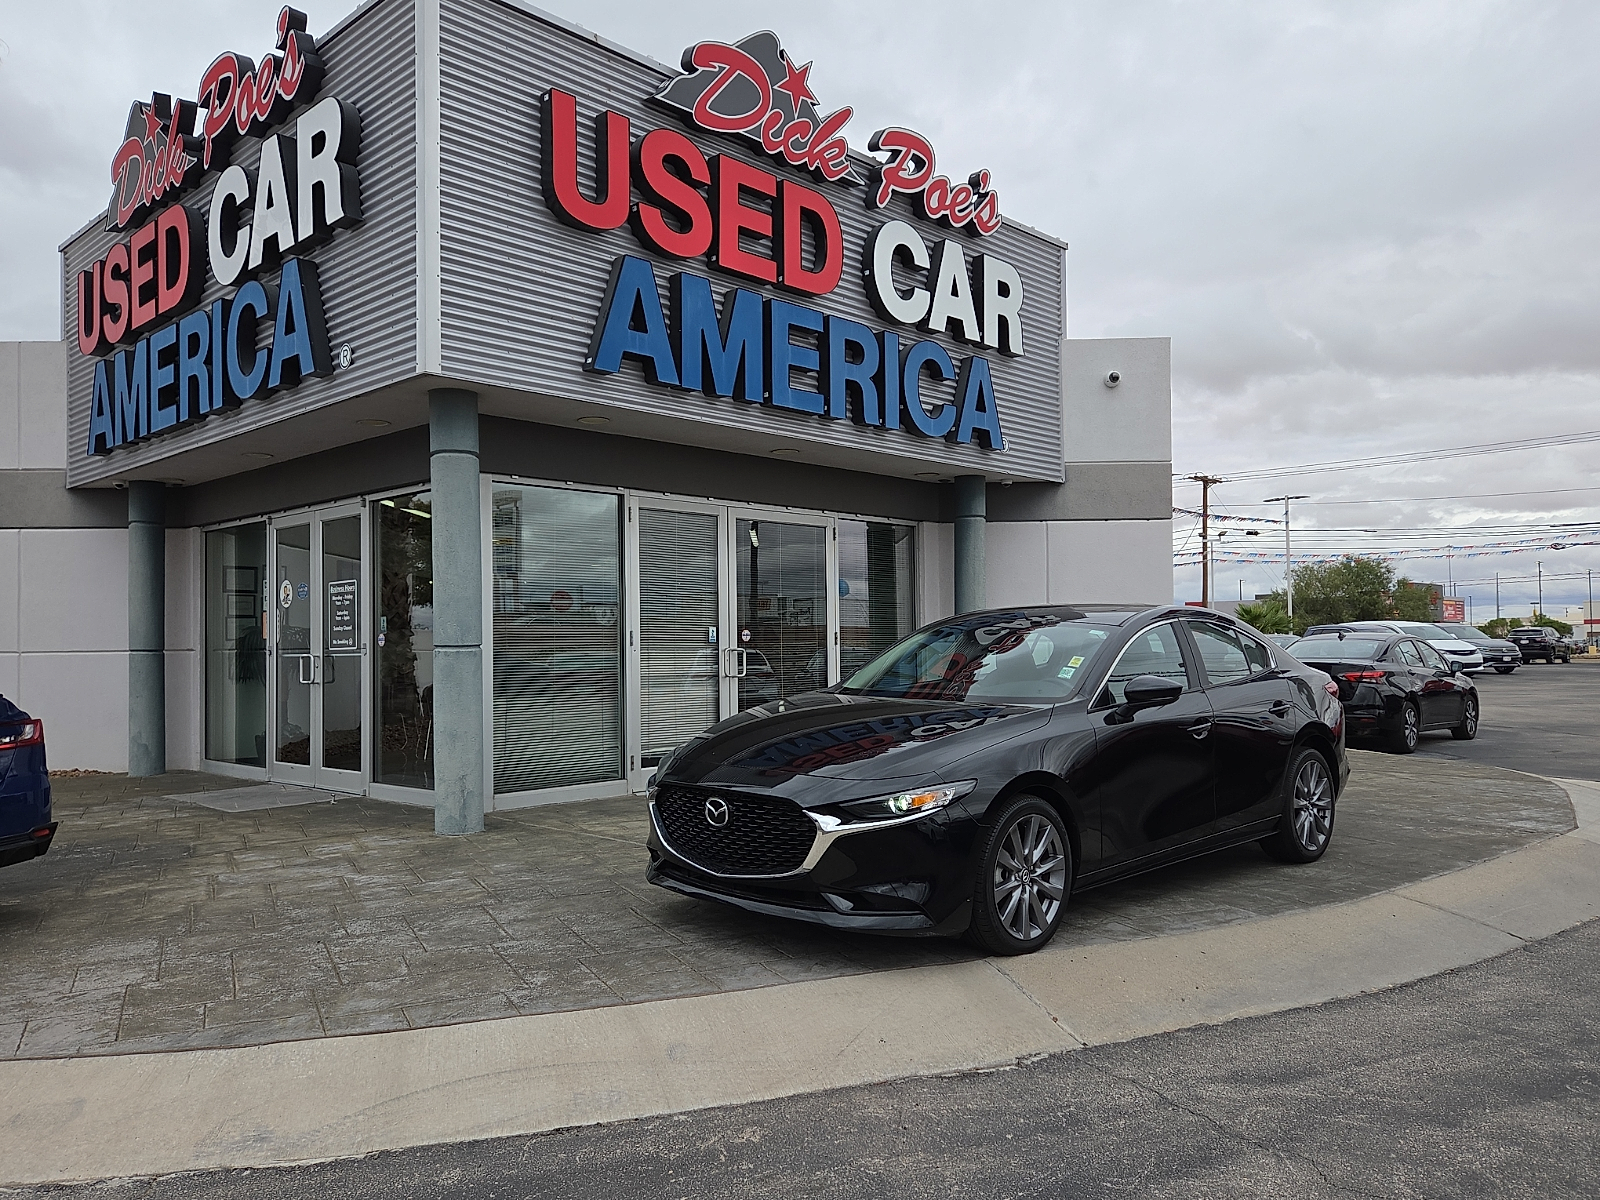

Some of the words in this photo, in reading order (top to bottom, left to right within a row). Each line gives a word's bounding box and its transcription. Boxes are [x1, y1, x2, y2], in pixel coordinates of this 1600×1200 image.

[110, 98, 188, 228] Dick
[199, 5, 305, 170] Poe's
[691, 40, 854, 181] Dick
[876, 127, 1002, 236] Poe's
[77, 204, 190, 356] USED
[209, 97, 344, 286] CAR
[551, 87, 844, 296] USED
[873, 220, 1025, 357] CAR
[87, 258, 315, 456] AMERICA
[594, 255, 1003, 450] AMERICA
